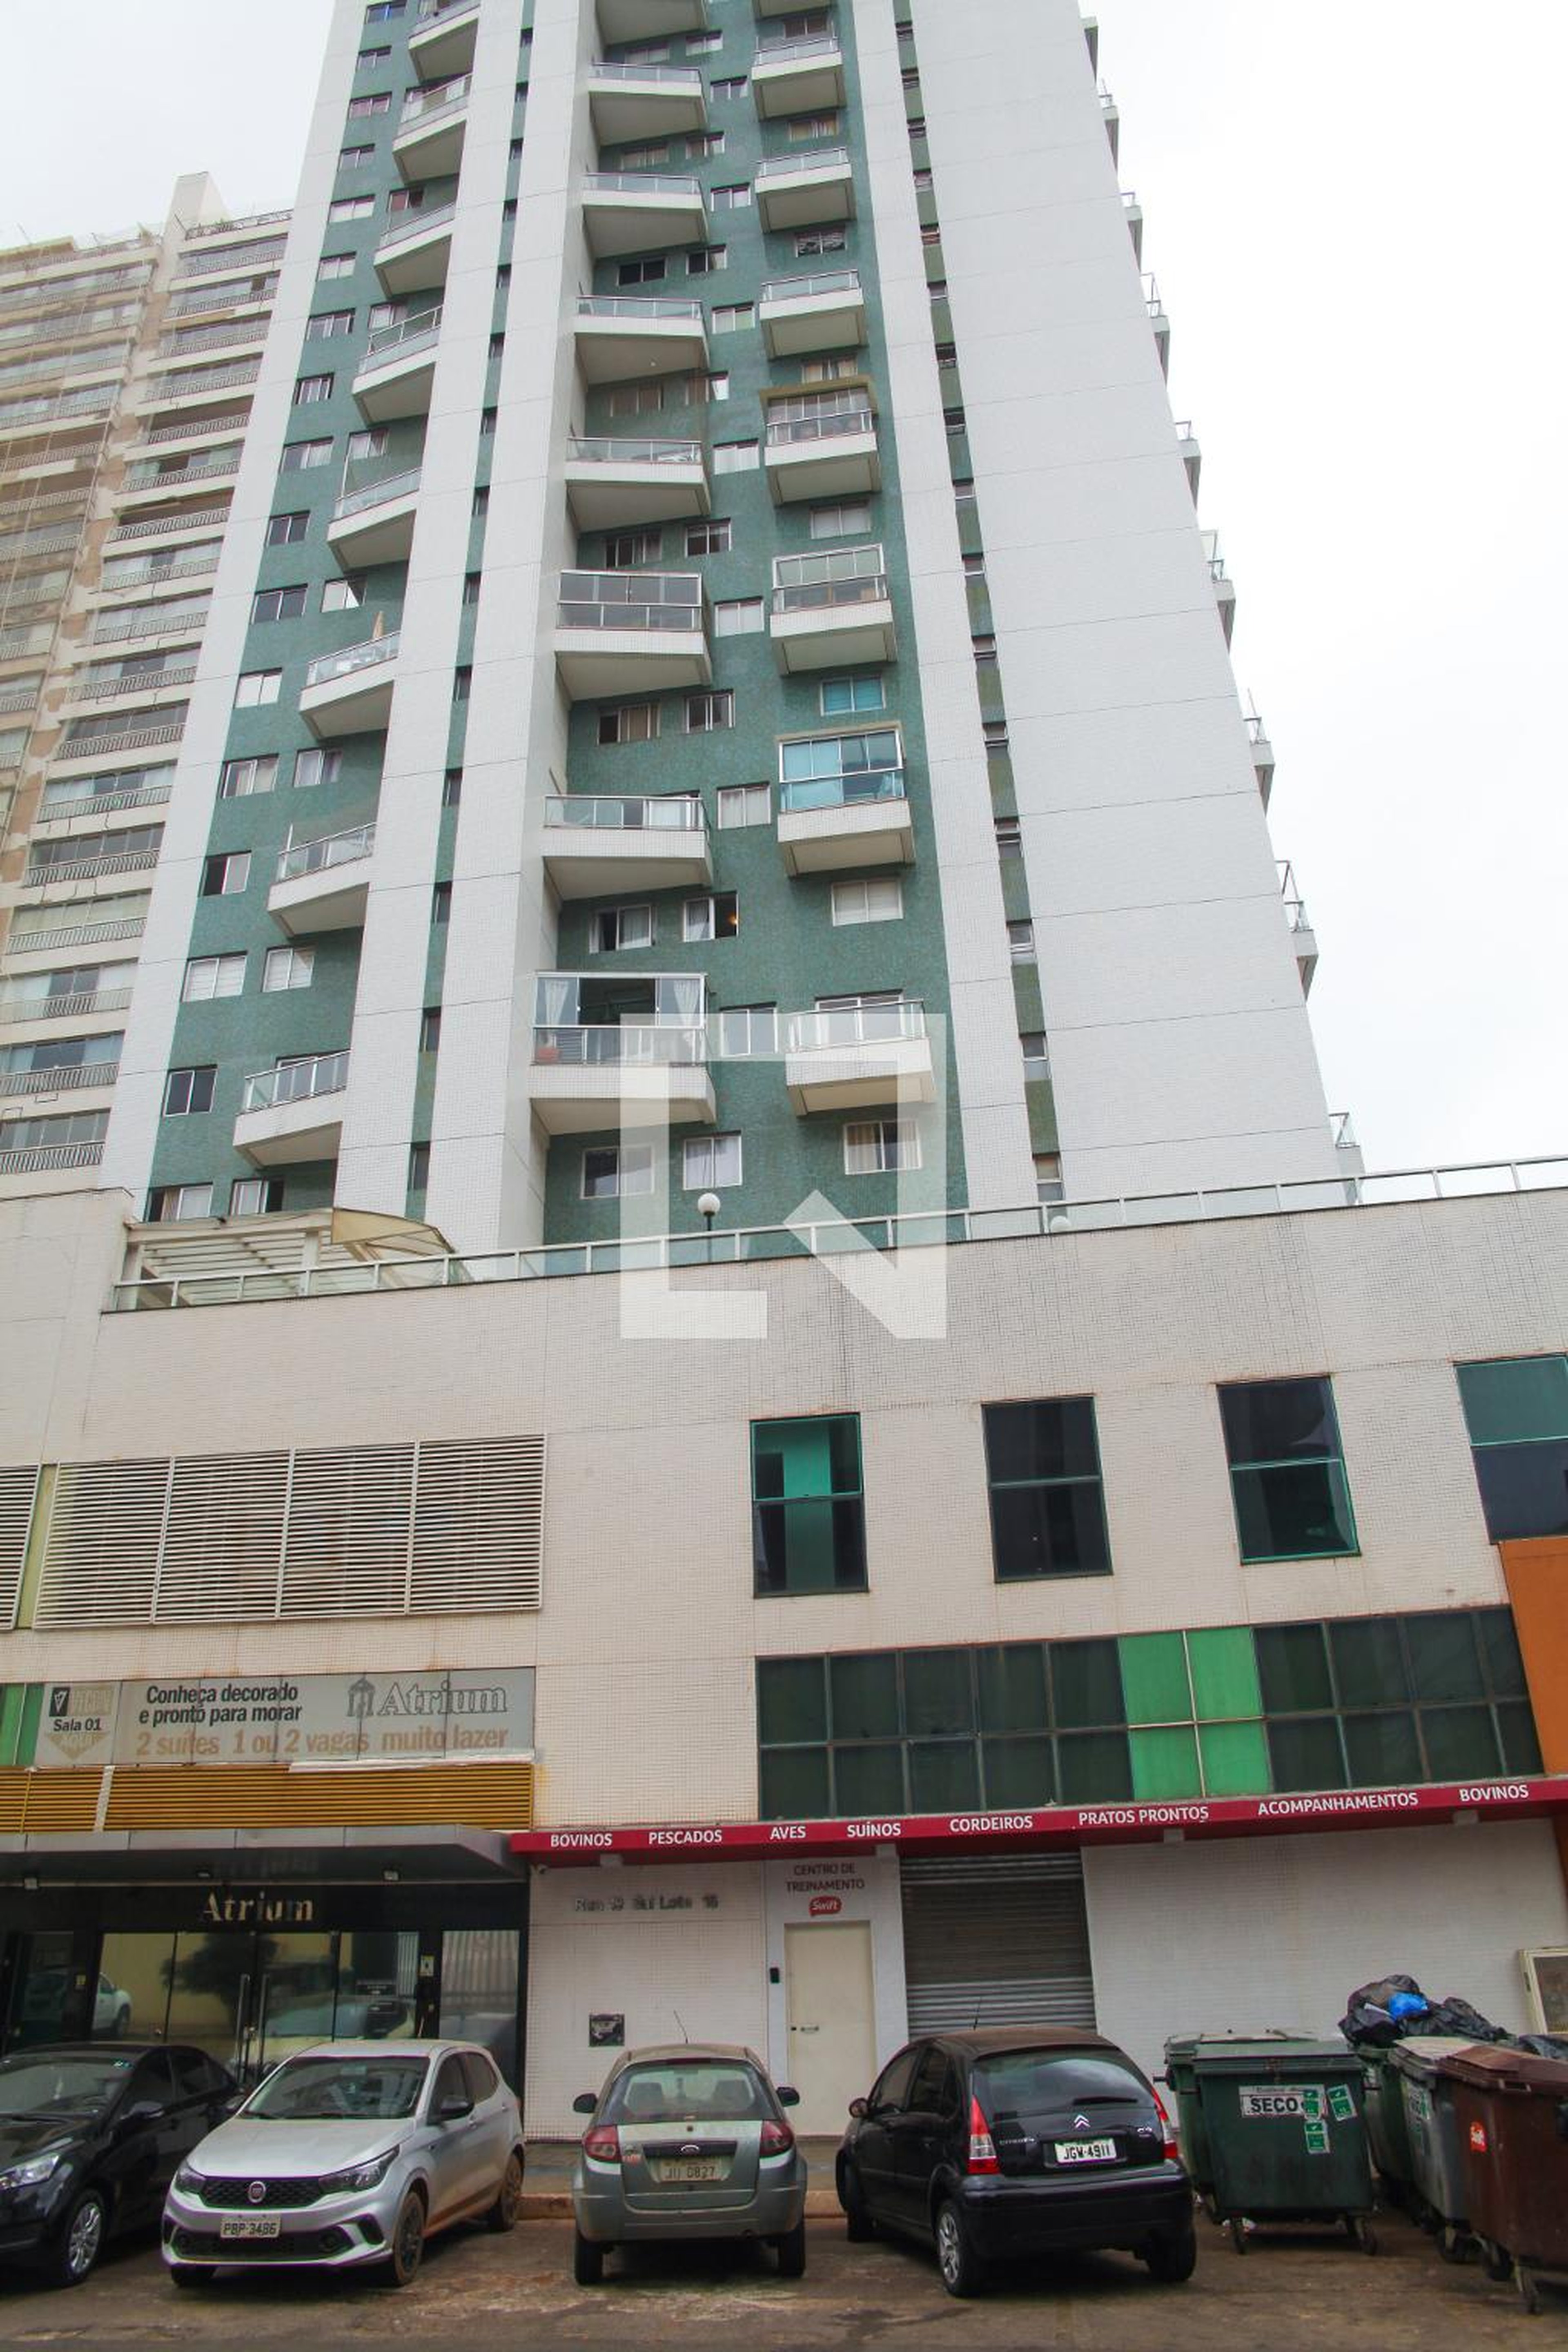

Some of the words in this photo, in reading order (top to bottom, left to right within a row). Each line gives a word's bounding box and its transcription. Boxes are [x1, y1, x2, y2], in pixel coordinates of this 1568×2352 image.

[147, 1685, 217, 1706] Conheça
[221, 1682, 298, 1702] decorado
[378, 1679, 508, 1715] Atrium
[53, 1719, 82, 1731] Sala
[85, 1717, 102, 1731] 01
[139, 1709, 149, 1724] e
[152, 1706, 206, 1727] pronto
[209, 1707, 246, 1726] para
[251, 1706, 303, 1722] morar
[136, 1732, 151, 1756] 2
[232, 1729, 245, 1754] 1
[252, 1733, 277, 1755] ou
[284, 1728, 300, 1753] 2
[306, 1731, 370, 1755] vagas
[381, 1725, 445, 1751] muito
[453, 1724, 508, 1749] lazer
[1459, 1784, 1529, 1802] BOVINOS
[1257, 1792, 1419, 1816] ACOMPANHAMENTOS
[950, 1815, 1033, 1833] CORDEIROS
[1078, 1810, 1135, 1826] PRATOS
[1139, 1806, 1209, 1823] PRONTOS
[648, 1829, 723, 1845] PESCADOS
[769, 1826, 806, 1840] AVES
[846, 1822, 901, 1838] SUÍNOS
[550, 1833, 612, 1848] BOVINOS
[794, 1863, 838, 1876] CENTRO
[840, 1862, 856, 1874] DE
[786, 1878, 865, 1893] TREINAMENTO
[204, 1891, 314, 1922] Atrium
[811, 1900, 838, 1911] Swift
[1250, 2098, 1298, 2112] SECO
